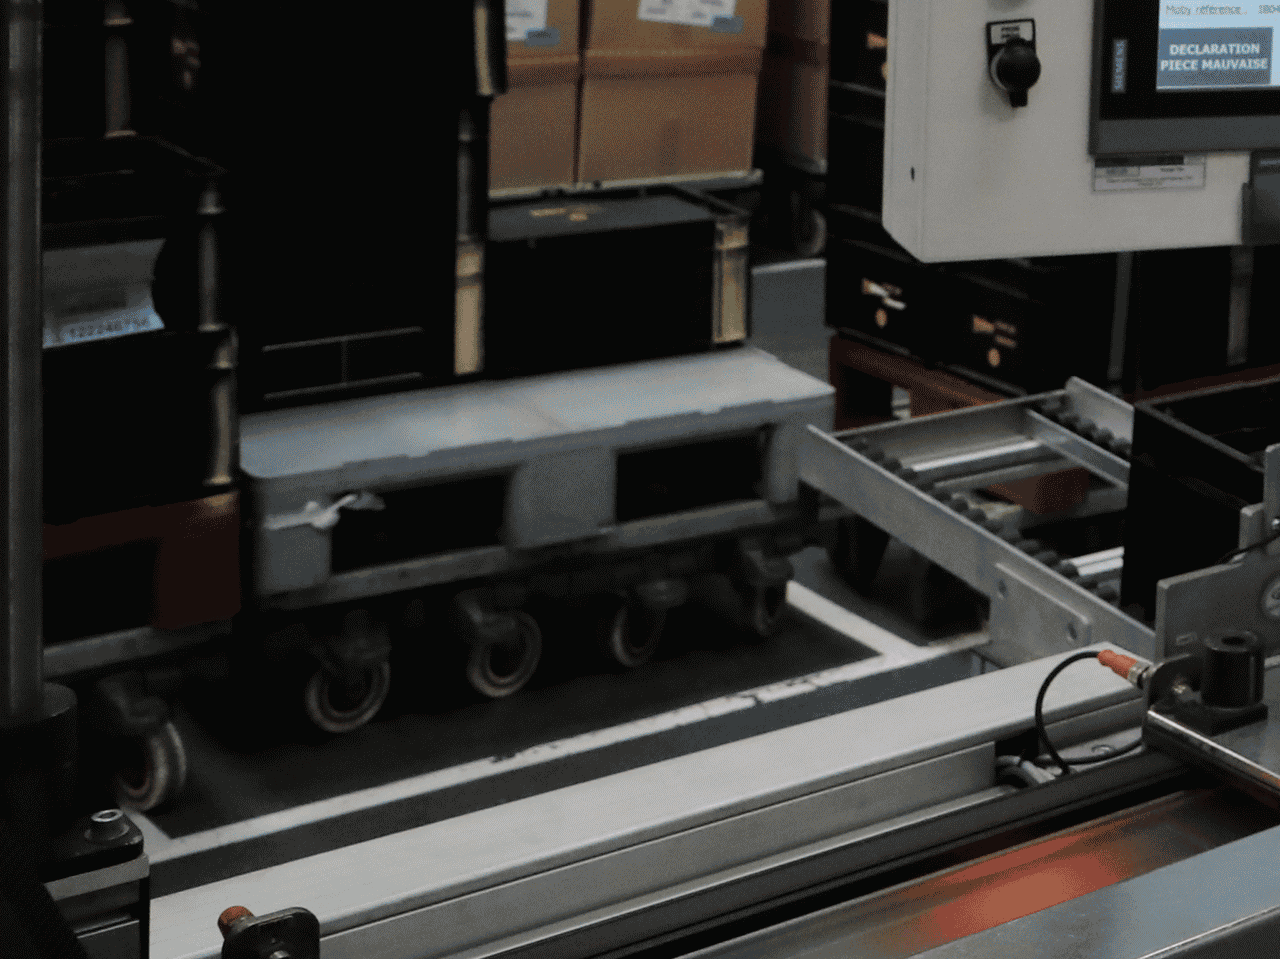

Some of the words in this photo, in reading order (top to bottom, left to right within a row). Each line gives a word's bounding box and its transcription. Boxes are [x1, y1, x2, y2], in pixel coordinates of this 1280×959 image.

[1169, 42, 1261, 57] DECLARATION
[1160, 59, 1199, 72] PIECE
[1202, 57, 1268, 72] MAUVAISE
